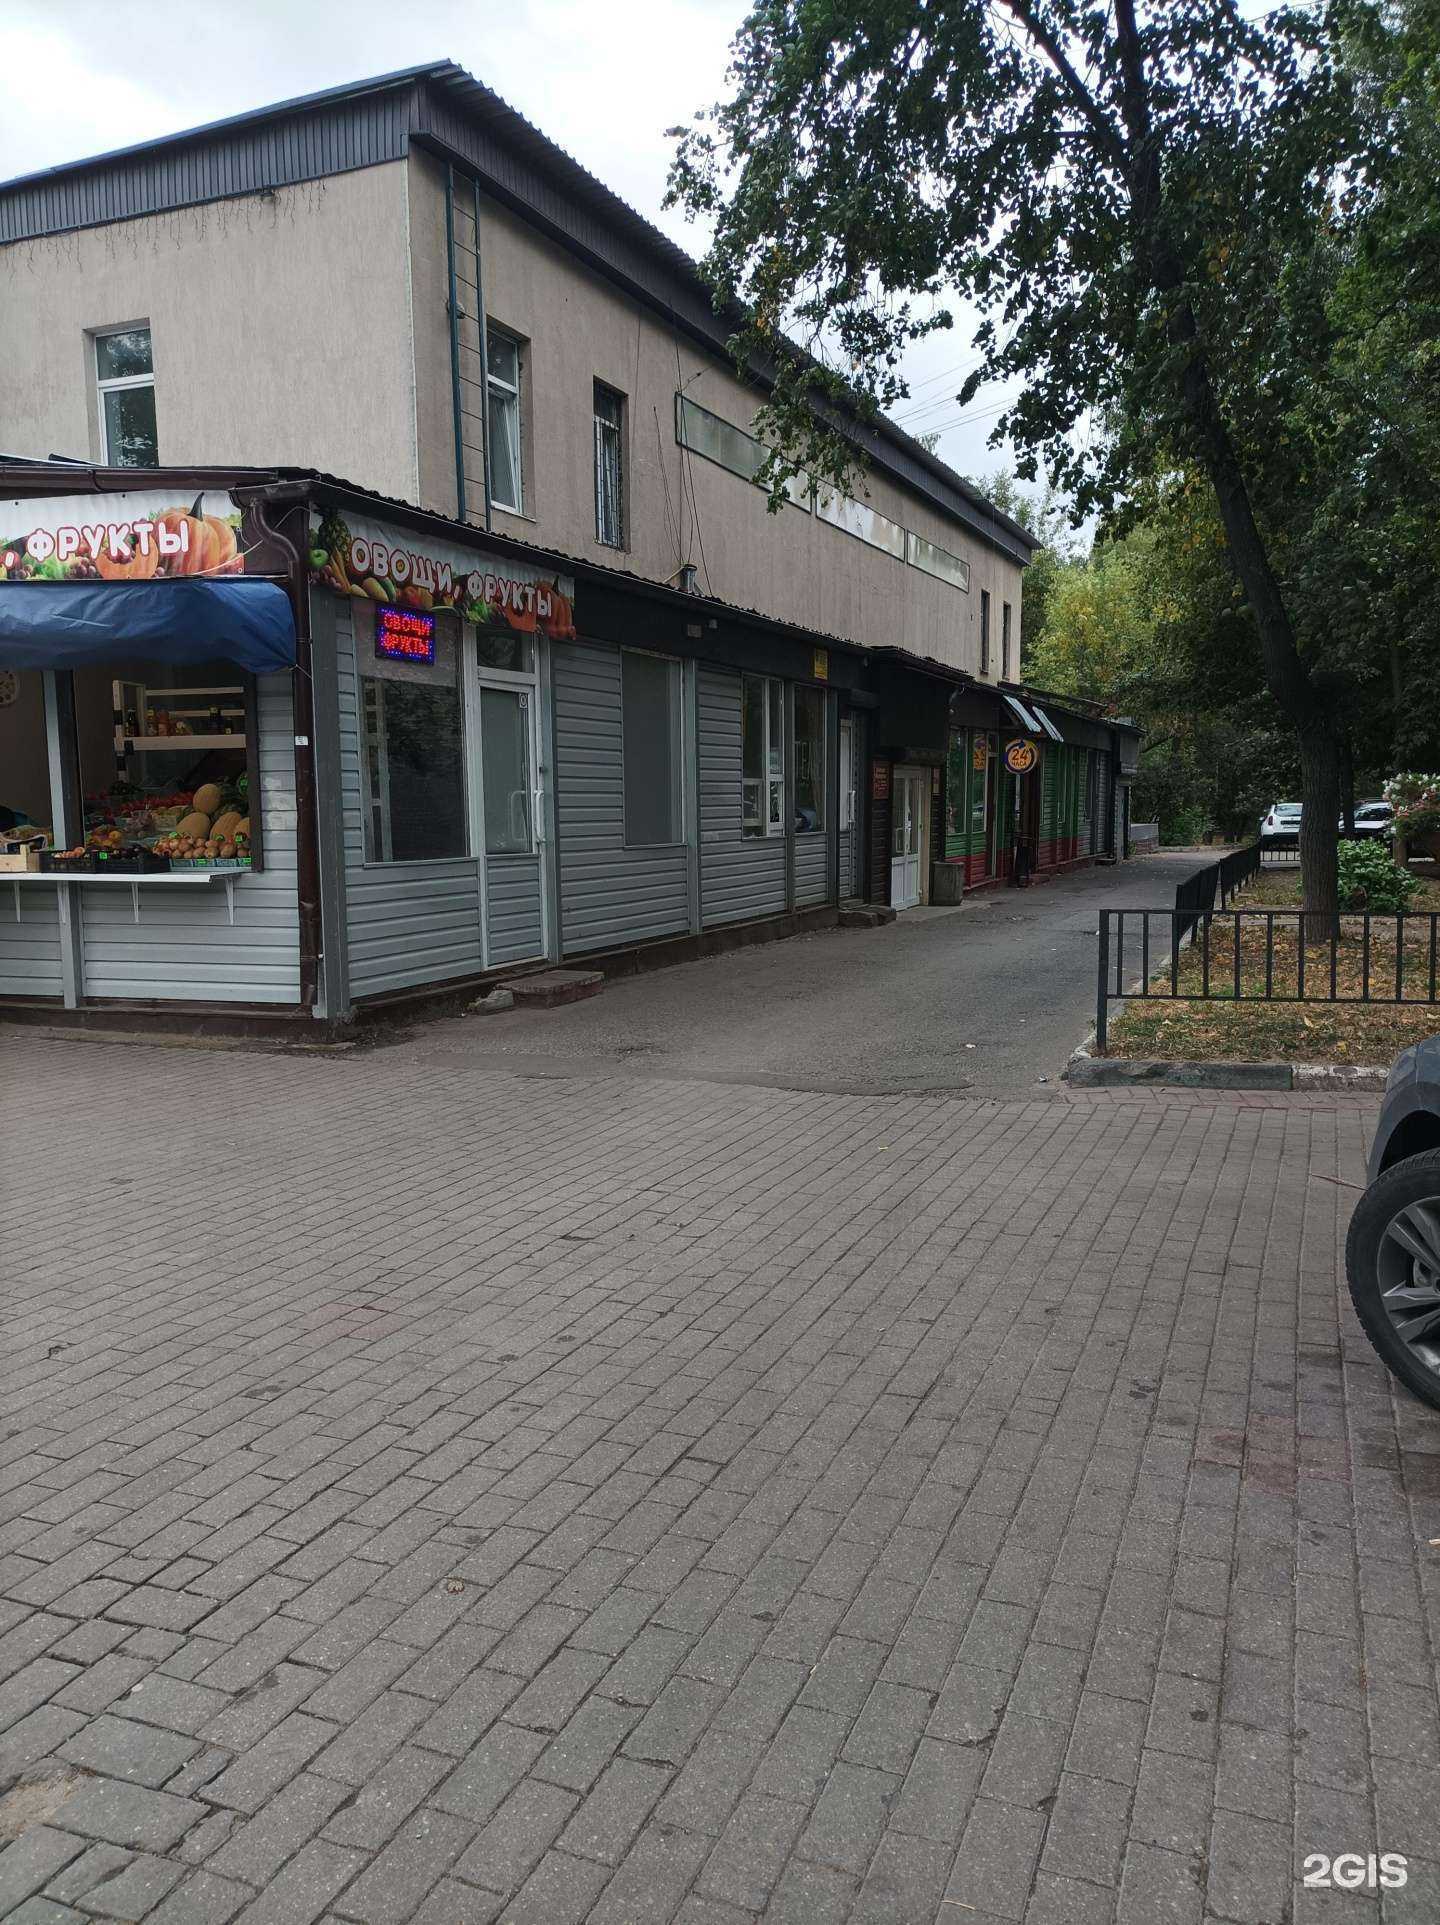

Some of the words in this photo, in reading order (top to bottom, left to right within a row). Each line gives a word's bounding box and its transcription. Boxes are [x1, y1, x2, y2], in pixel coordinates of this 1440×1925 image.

[27, 519, 190, 563] ФРУКТЫ
[351, 537, 460, 599] ОВОЩИ,
[467, 570, 552, 618] ФРУКТЫ
[384, 613, 430, 636] ОВОЩИ
[383, 632, 429, 655] ФРУКТЫ
[1012, 748, 1029, 761] 24
